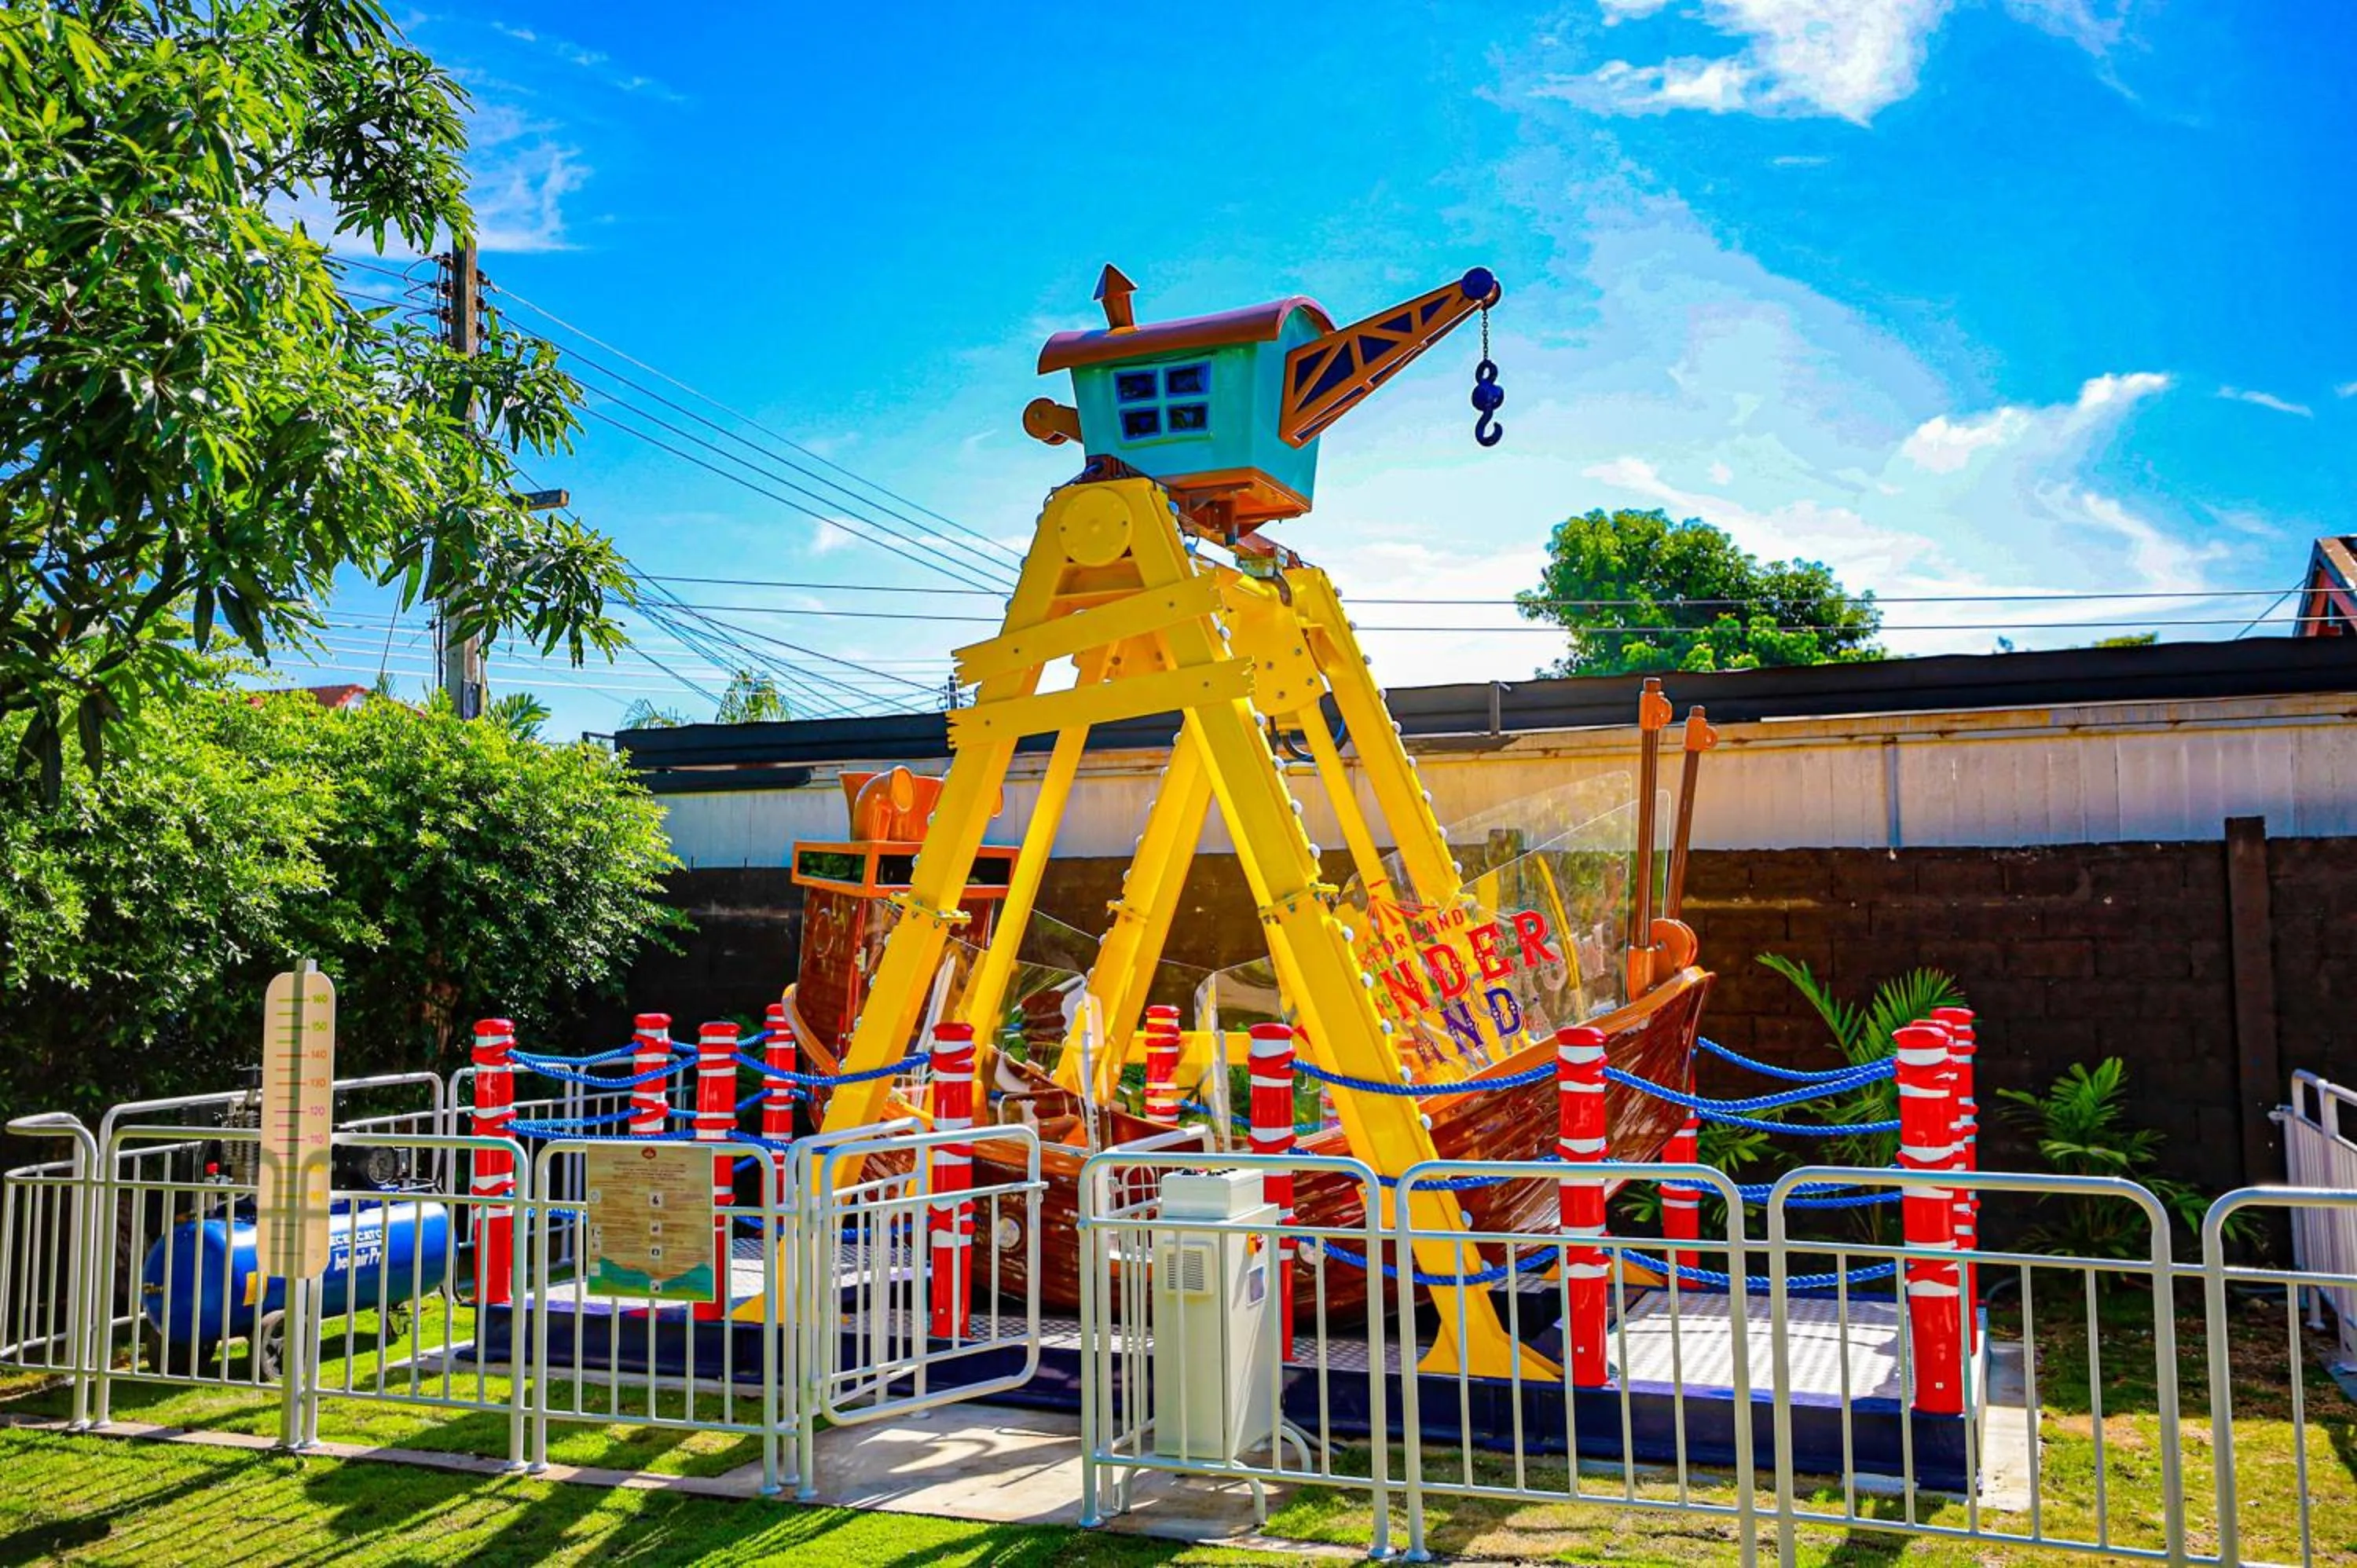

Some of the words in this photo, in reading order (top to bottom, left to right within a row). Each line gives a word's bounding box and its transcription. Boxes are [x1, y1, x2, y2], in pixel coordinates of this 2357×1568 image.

[1379, 909, 1558, 1020] NDER
[313, 994, 328, 1004] 160
[313, 1021, 328, 1031] 150
[1413, 987, 1523, 1071] AND
[311, 1050, 328, 1060] 140
[310, 1078, 326, 1088] 130
[310, 1105, 325, 1116] 120
[310, 1134, 324, 1145] 110
